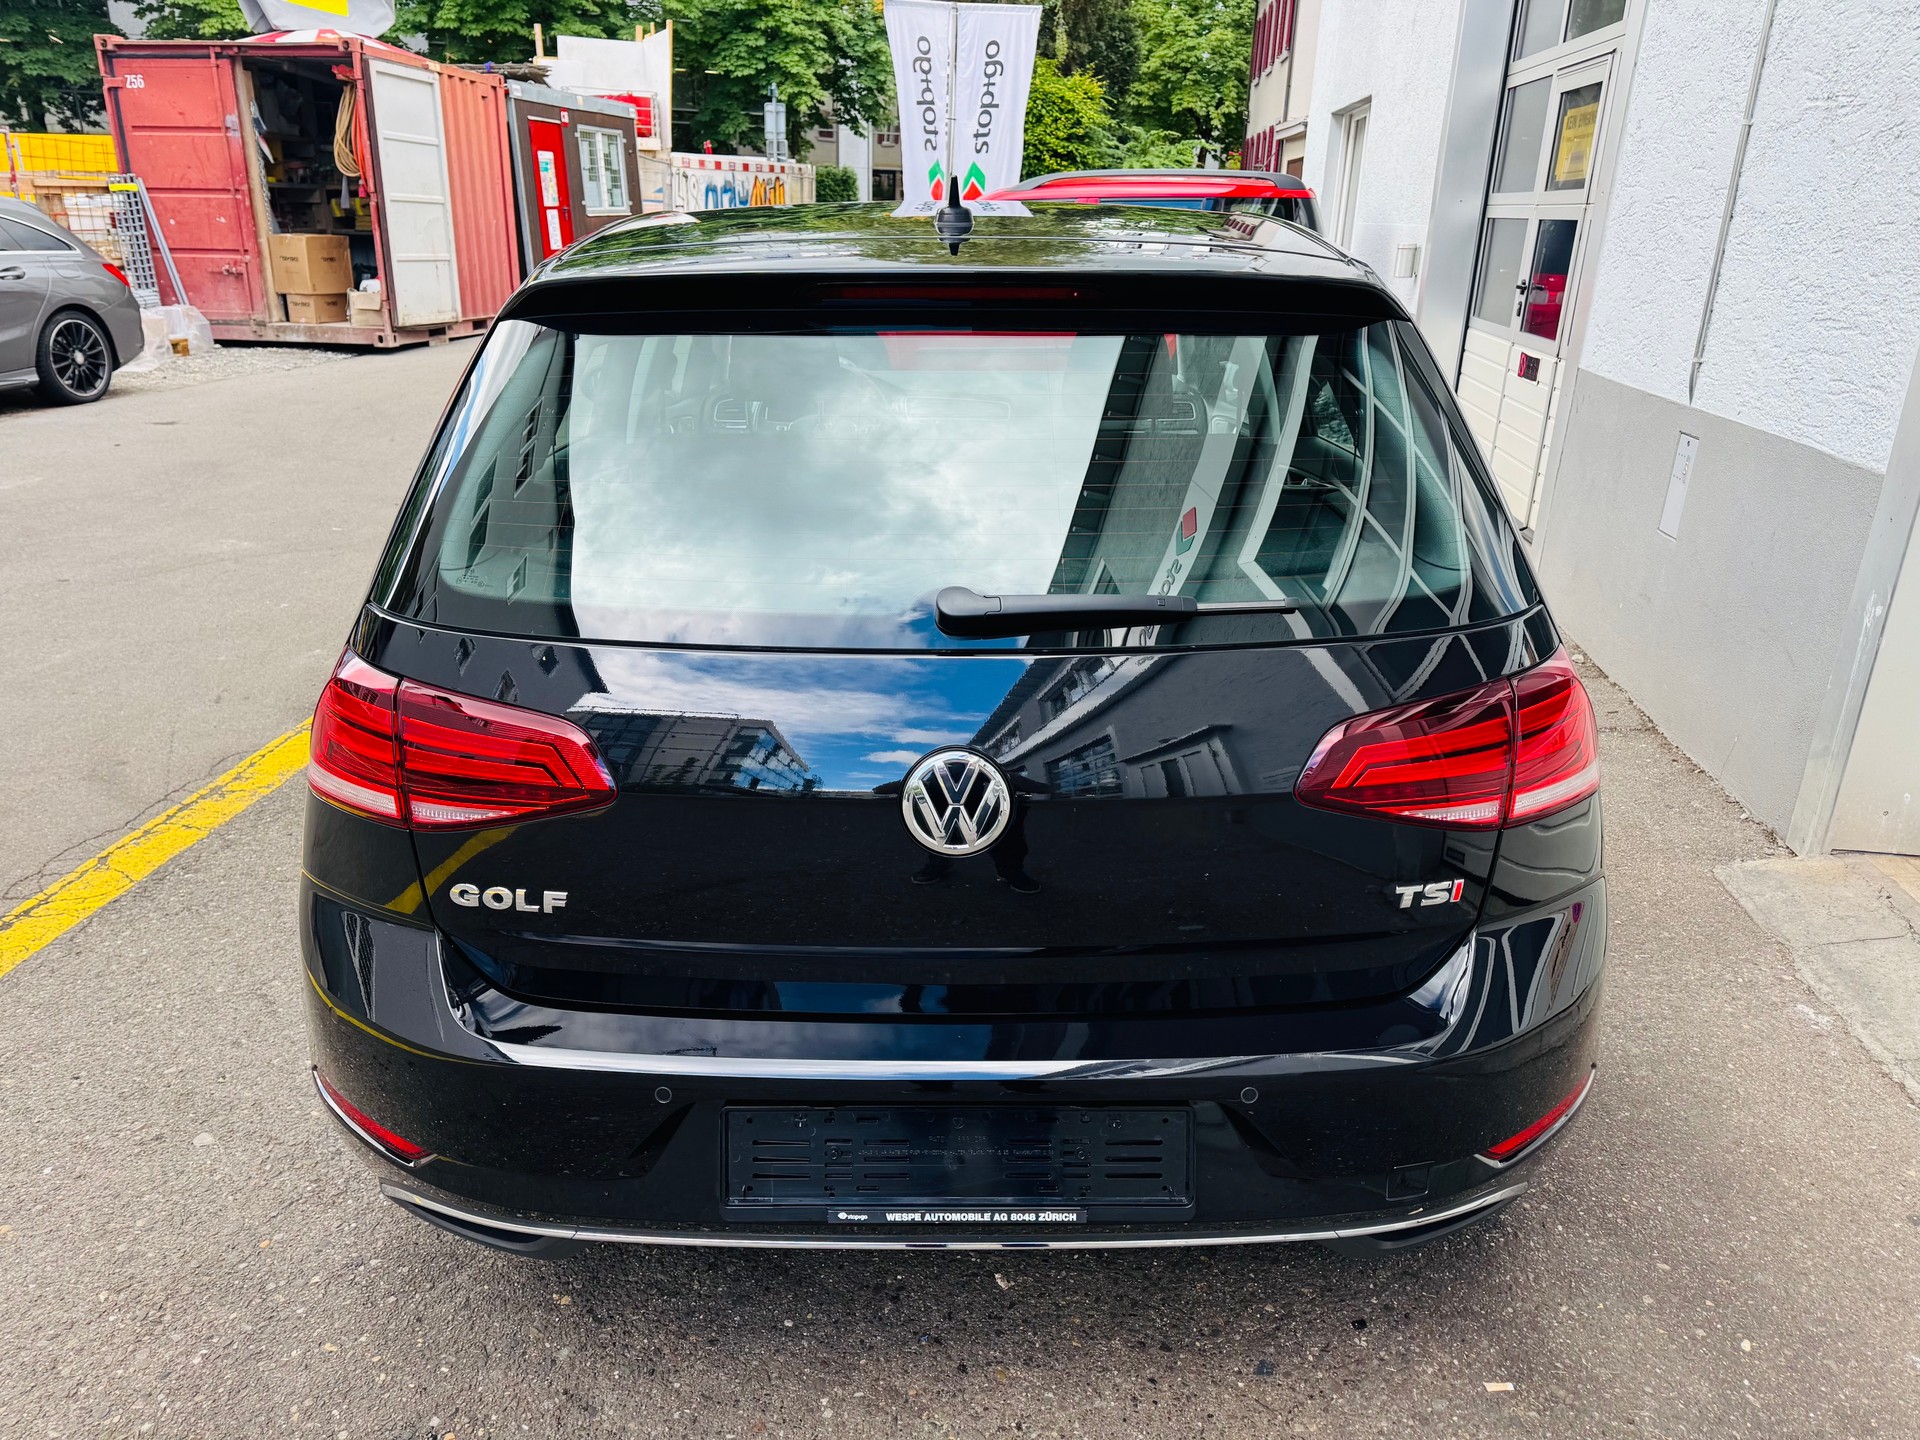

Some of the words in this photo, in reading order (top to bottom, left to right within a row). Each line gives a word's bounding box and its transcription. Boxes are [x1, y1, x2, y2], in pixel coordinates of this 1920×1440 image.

[973, 40, 1004, 154] stop+go
[449, 883, 569, 914] GOLF
[885, 1212, 921, 1222] WESPE
[923, 1212, 991, 1222] AUTOMOBILE
[993, 1212, 1008, 1222] AG
[1010, 1212, 1036, 1222] 8048
[1038, 1211, 1077, 1222] ZÜRICH
